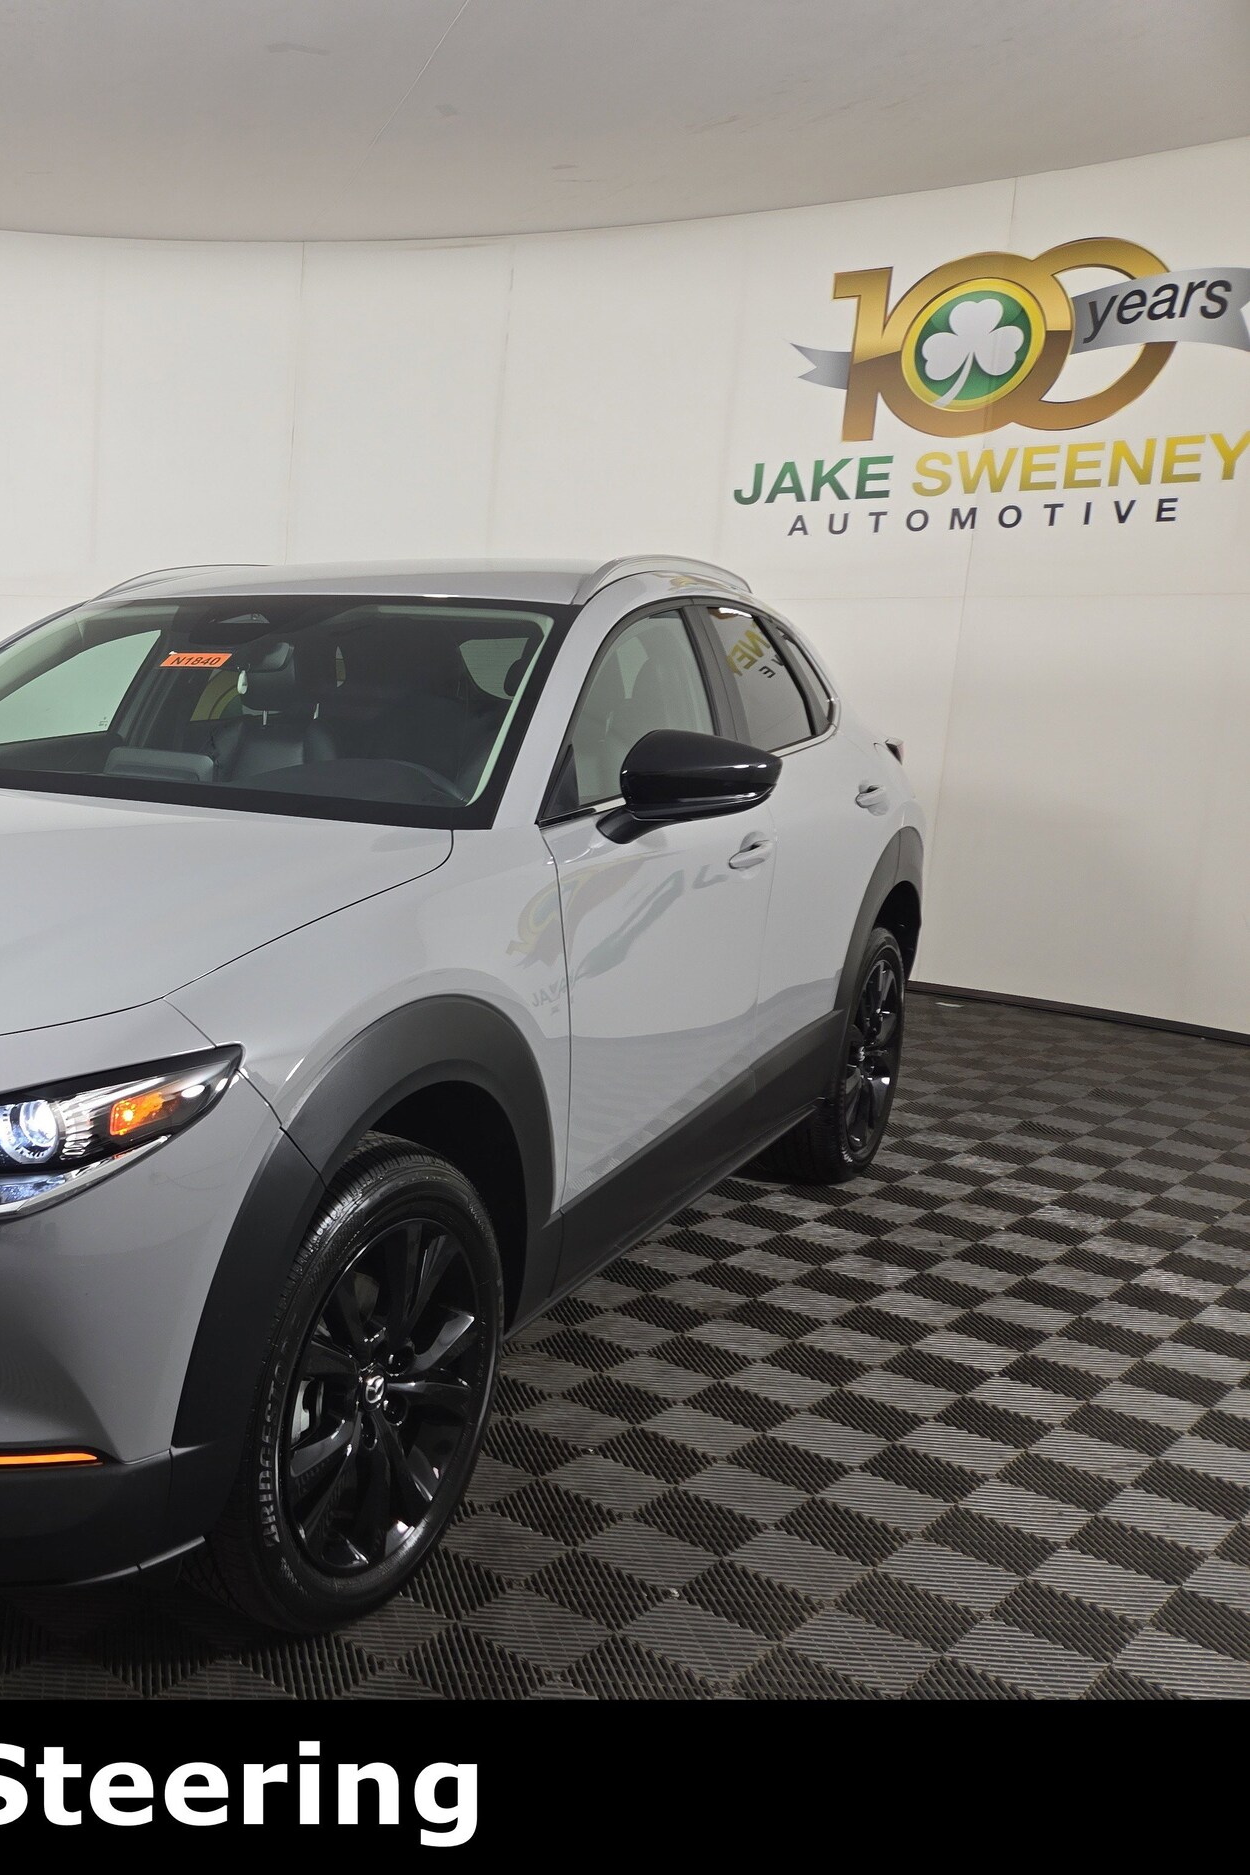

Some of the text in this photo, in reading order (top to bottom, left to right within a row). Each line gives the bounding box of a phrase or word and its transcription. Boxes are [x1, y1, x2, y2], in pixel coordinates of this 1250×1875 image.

[832, 236, 1232, 443] 100 years
[733, 430, 1250, 506] JAKE SWEENEY
[787, 497, 1179, 537] AUTOMOTIVE
[170, 656, 222, 666] N1840
